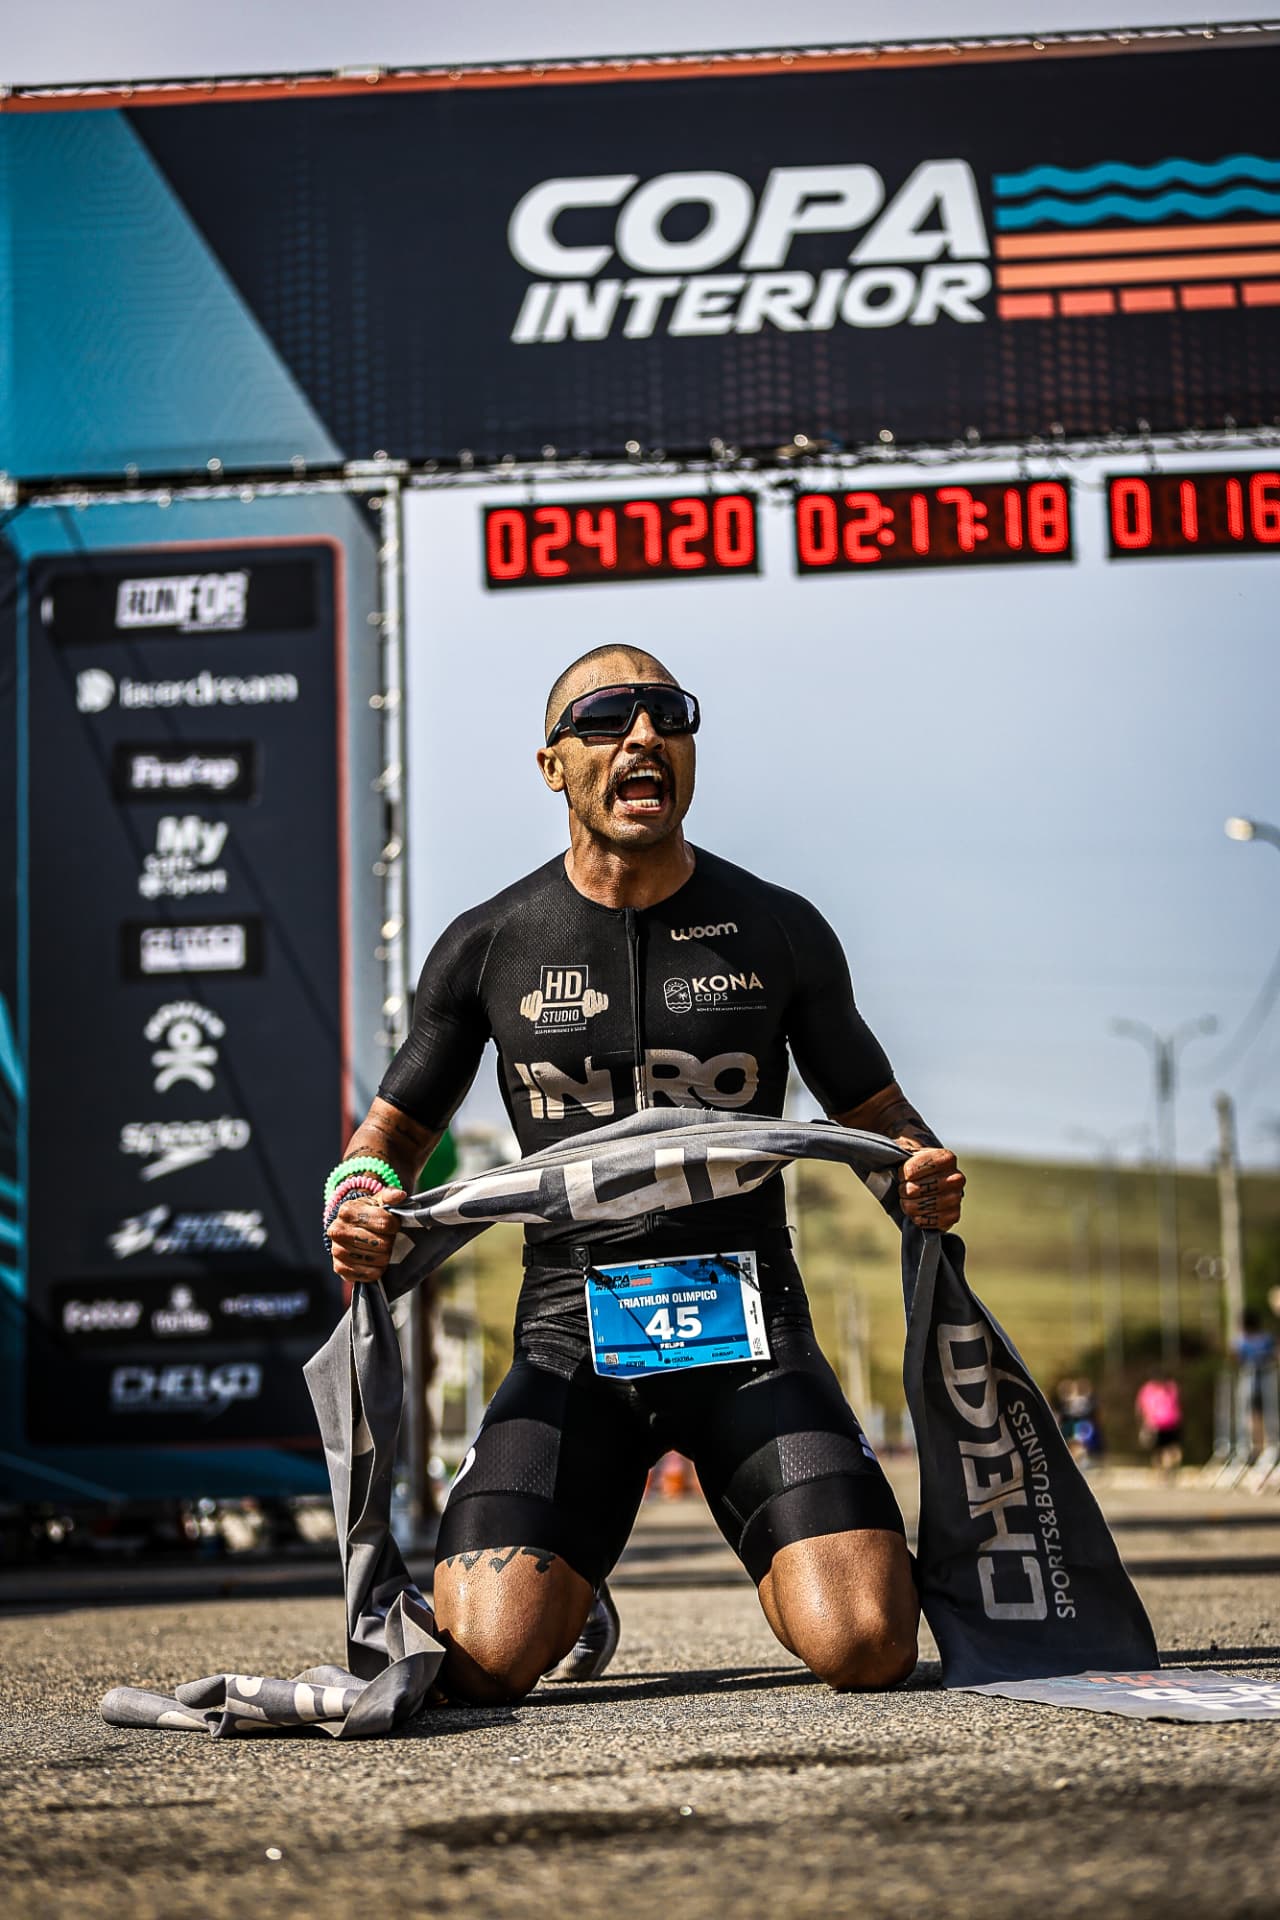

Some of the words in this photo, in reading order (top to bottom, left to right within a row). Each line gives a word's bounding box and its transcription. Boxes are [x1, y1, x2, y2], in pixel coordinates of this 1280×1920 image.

[507, 158, 991, 279] COPA
[511, 262, 993, 344] INTERIOR
[797, 481, 1069, 567] 02:17:18
[670, 922, 738, 941] woom
[545, 970, 582, 1000] HD
[691, 972, 764, 993] KONA
[695, 992, 728, 1006] caps
[542, 1009, 580, 1023] STUDIO
[618, 1293, 670, 1309] TRIATHLON
[672, 1288, 717, 1304] OLIMPICO
[645, 1305, 702, 1340] 45
[1007, 1399, 1076, 1620] SPORTS&BUSINESS
